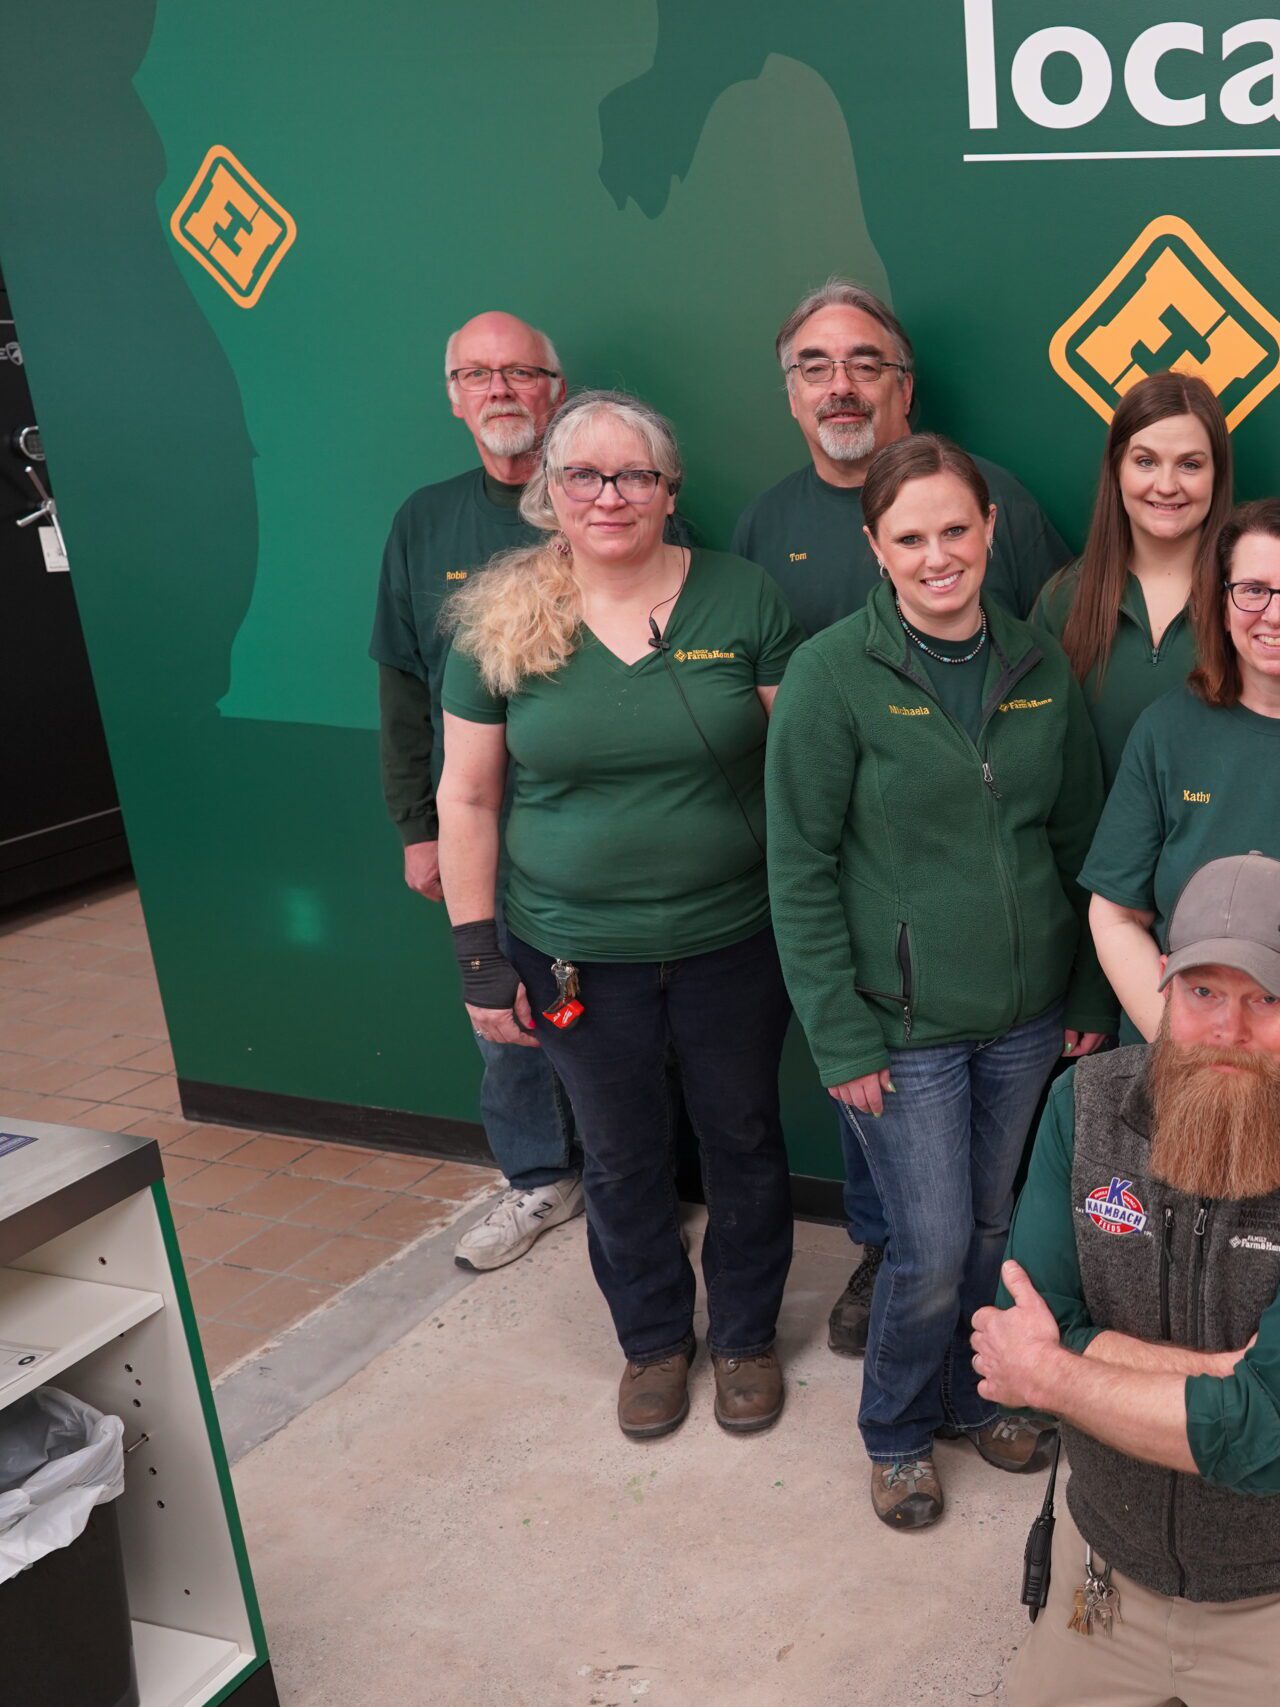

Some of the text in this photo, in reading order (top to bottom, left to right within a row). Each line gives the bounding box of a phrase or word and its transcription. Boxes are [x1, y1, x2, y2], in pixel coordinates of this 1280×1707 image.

[790, 552, 807, 562] Tom
[889, 704, 930, 717] Michaela
[1183, 789, 1211, 804] Kathy
[1087, 1199, 1143, 1227] KALMBACH
[1098, 1220, 1121, 1233] FEEDS
